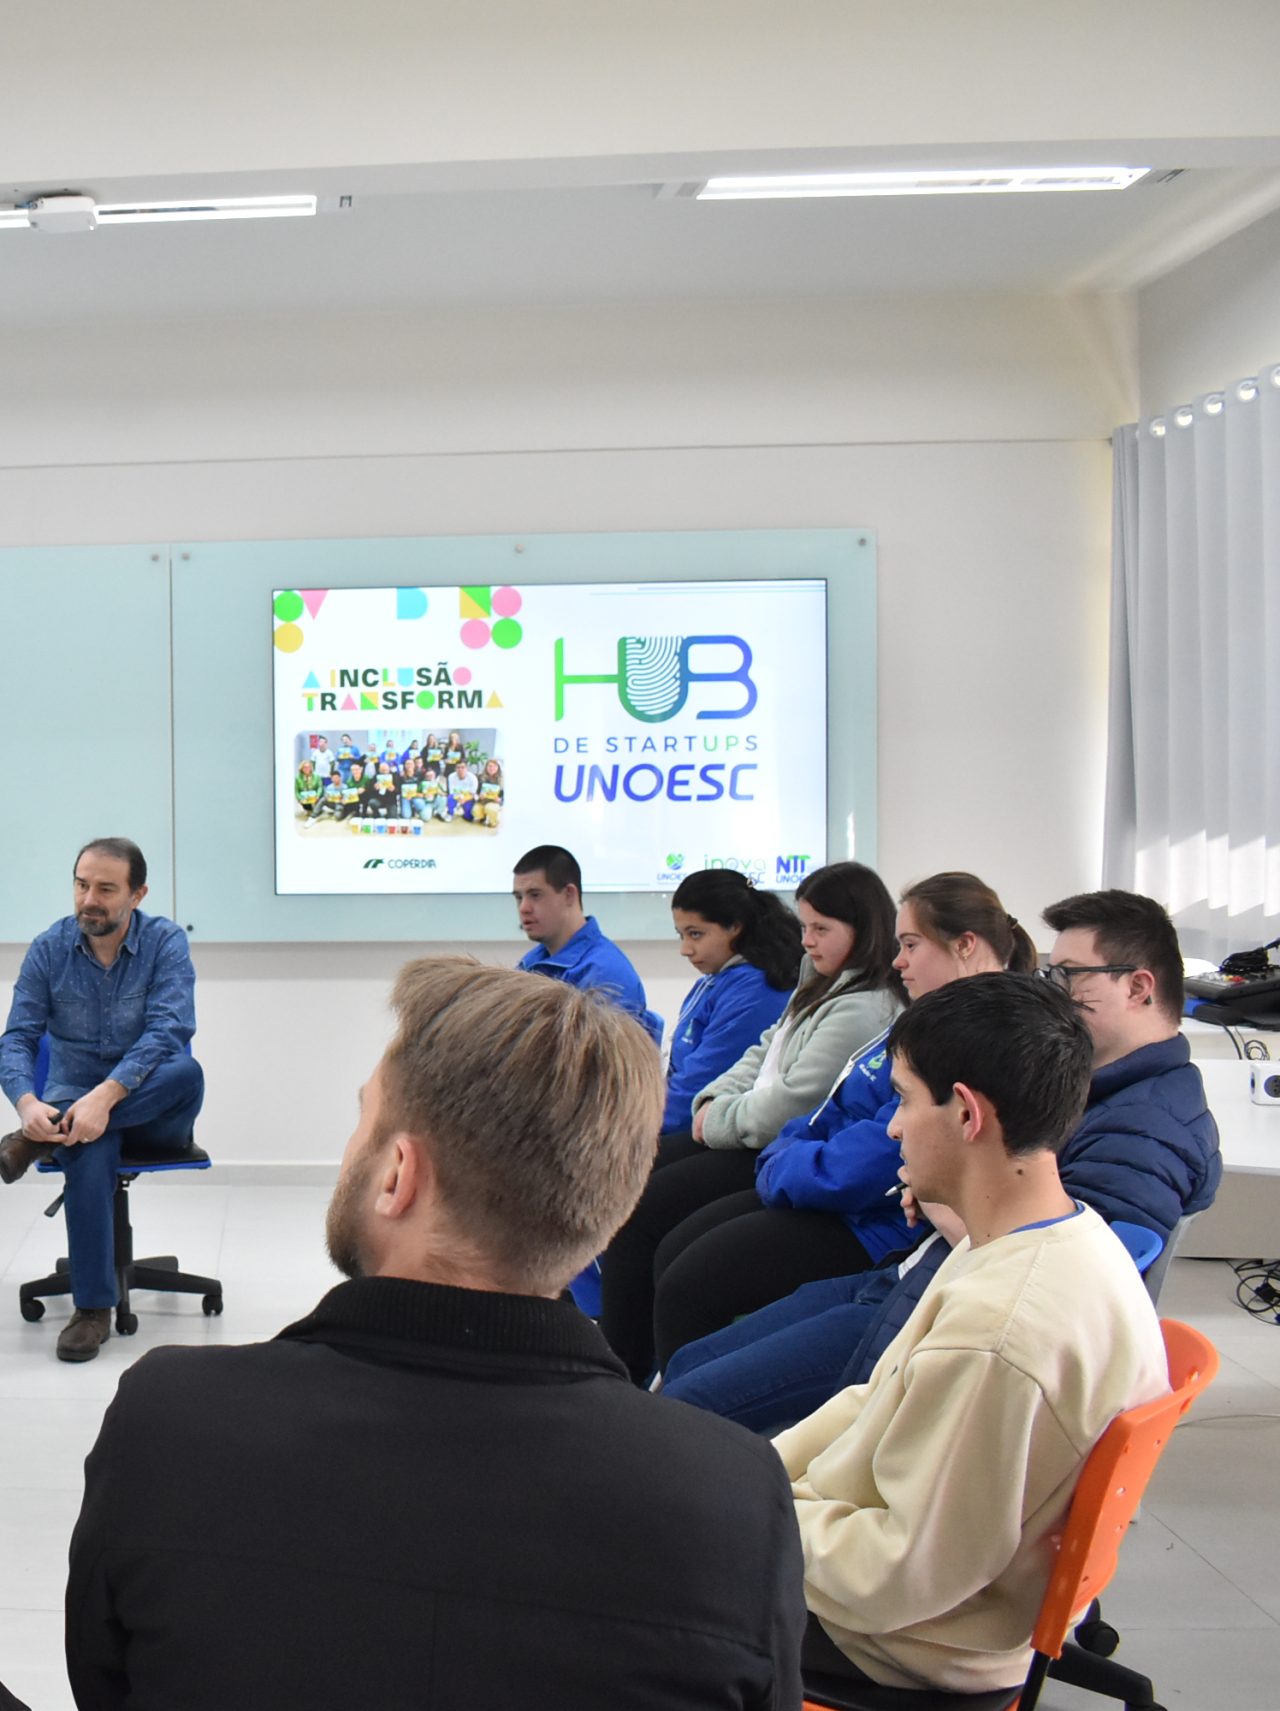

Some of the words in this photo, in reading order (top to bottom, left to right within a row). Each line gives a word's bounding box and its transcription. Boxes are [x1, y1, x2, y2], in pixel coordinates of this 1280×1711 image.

[330, 661, 472, 688] INCLUSÃO
[554, 635, 758, 723] HUB
[302, 690, 504, 711] TRANSFORMA
[554, 737, 589, 753] DE
[605, 735, 758, 753] STARTUPS
[554, 763, 758, 803] UNOESC
